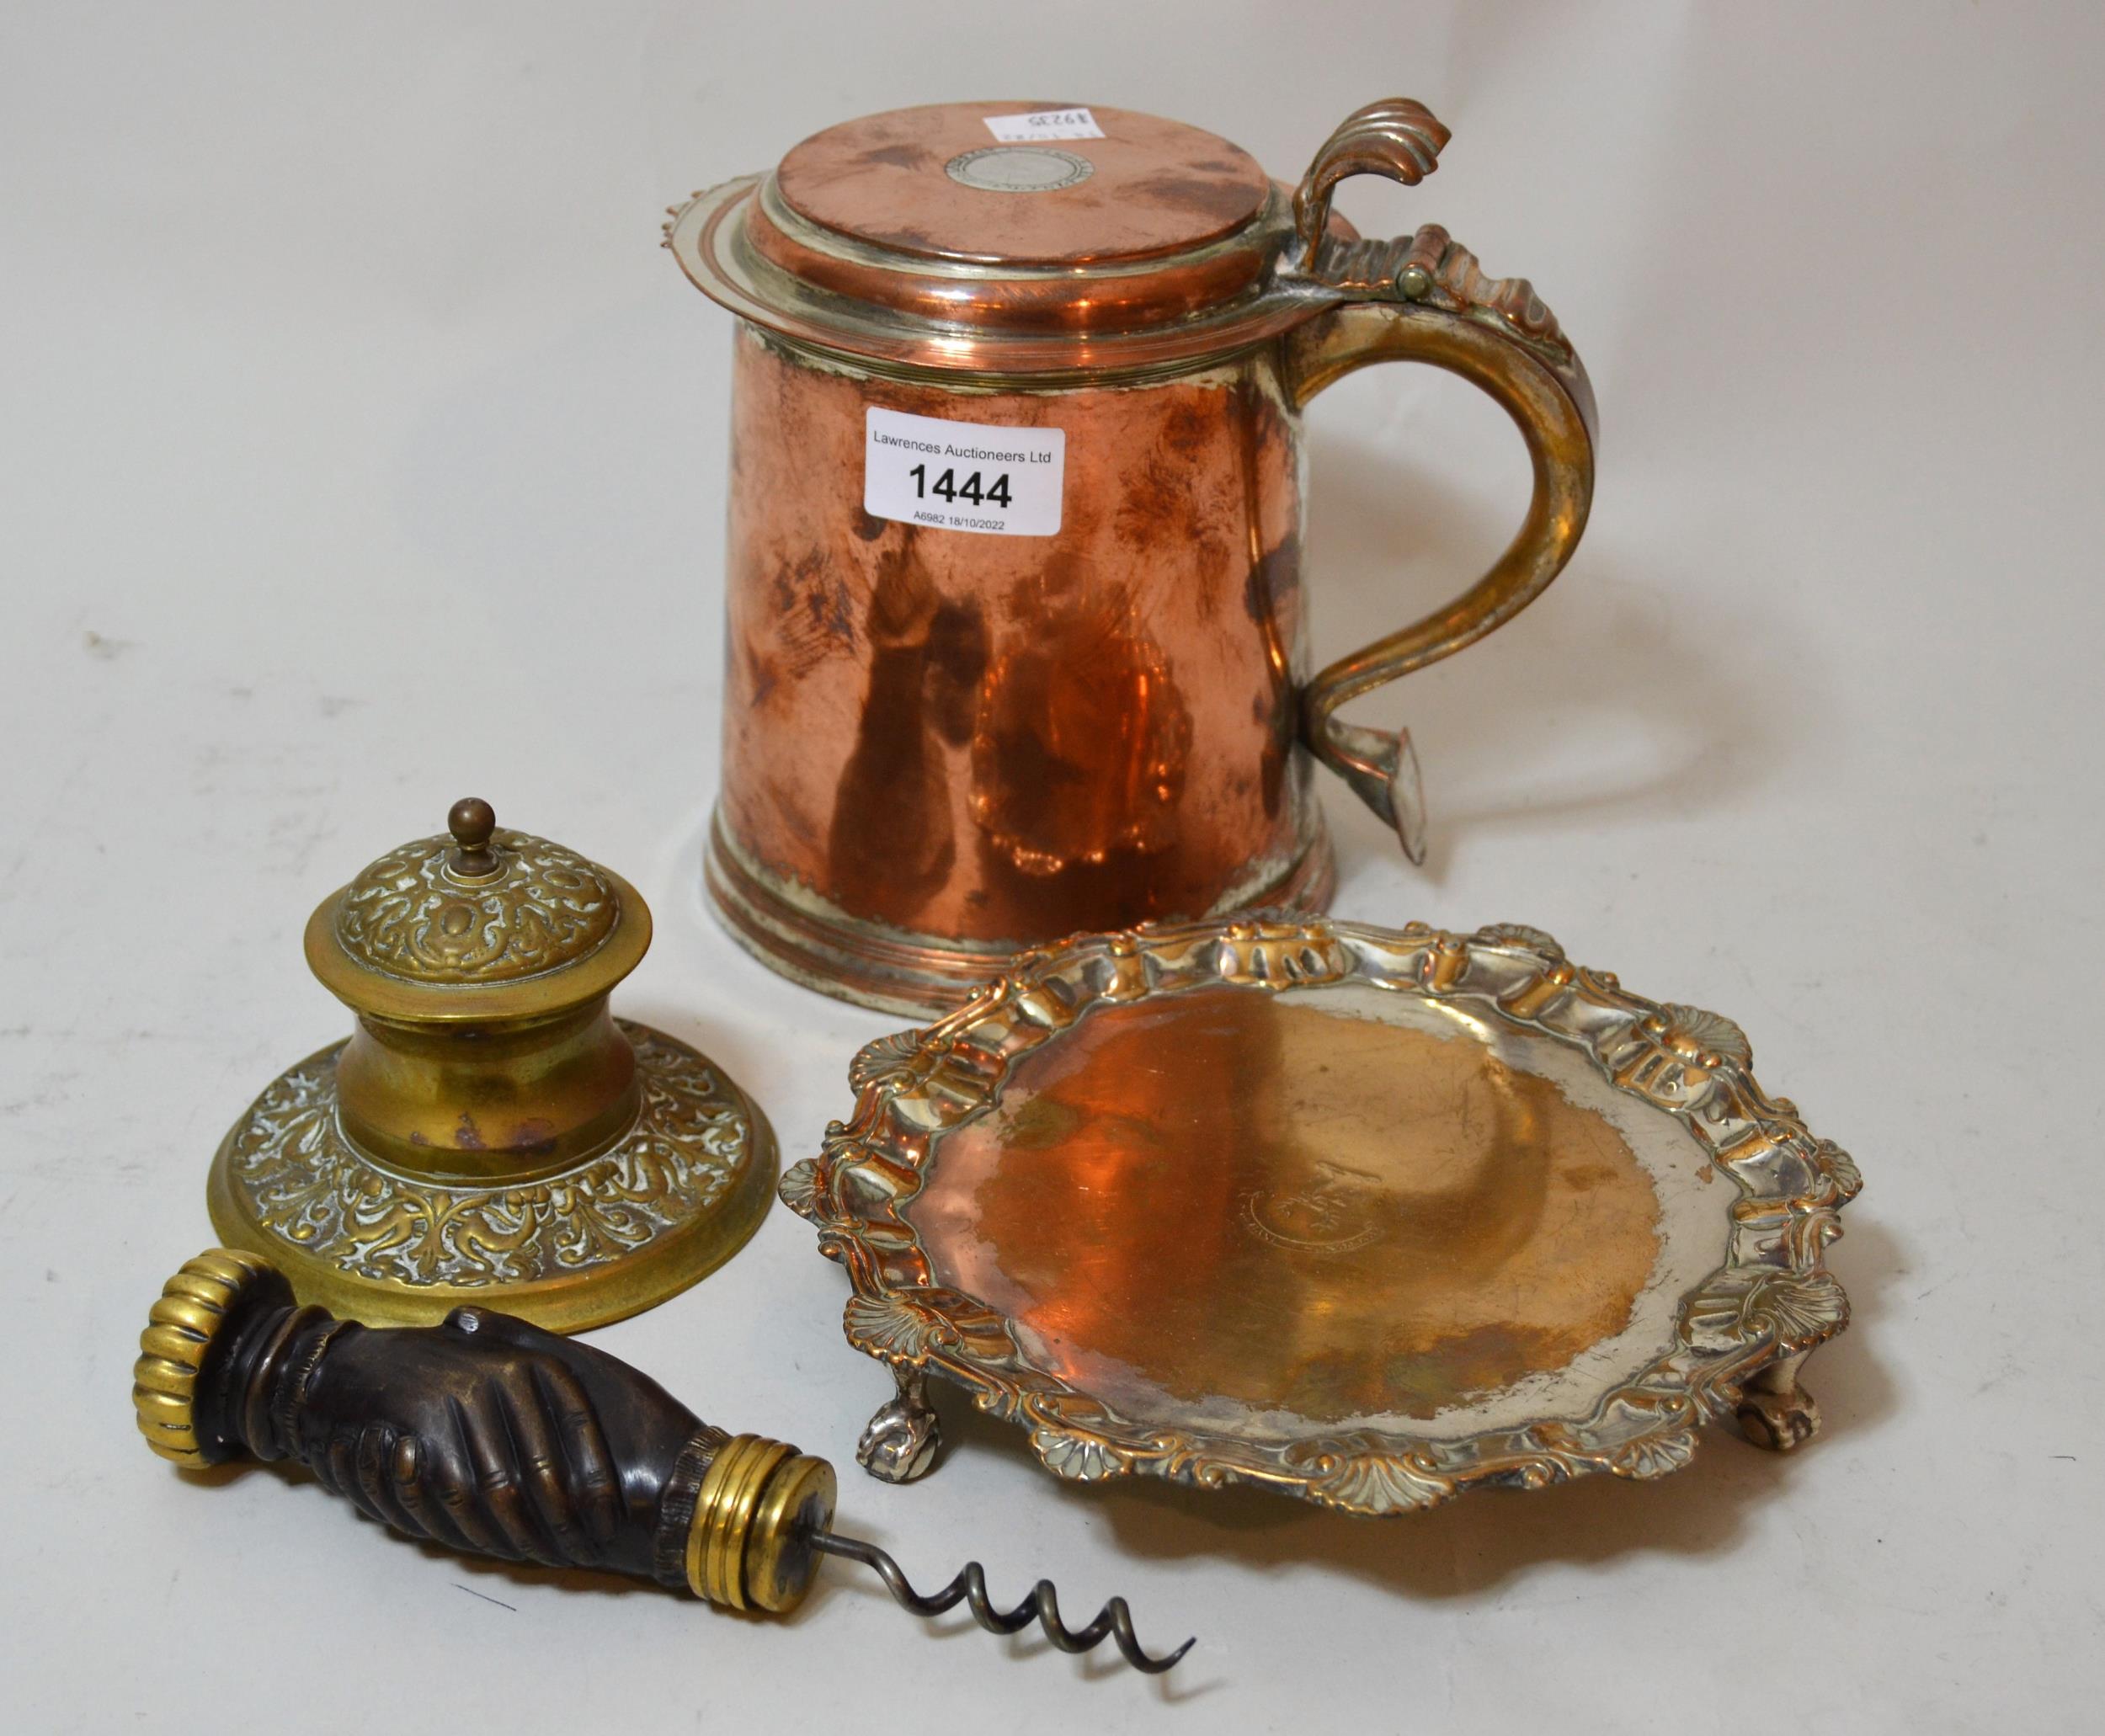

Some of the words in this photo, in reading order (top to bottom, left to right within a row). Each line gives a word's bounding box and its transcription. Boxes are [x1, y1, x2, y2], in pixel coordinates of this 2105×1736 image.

[874, 430, 941, 454] Lawrences
[945, 445, 1026, 462] Auctioneers
[1030, 450, 1052, 463] Ltd
[909, 463, 1012, 509] 1444
[914, 511, 945, 525] A6982
[949, 516, 1005, 530] 18/10/2022
